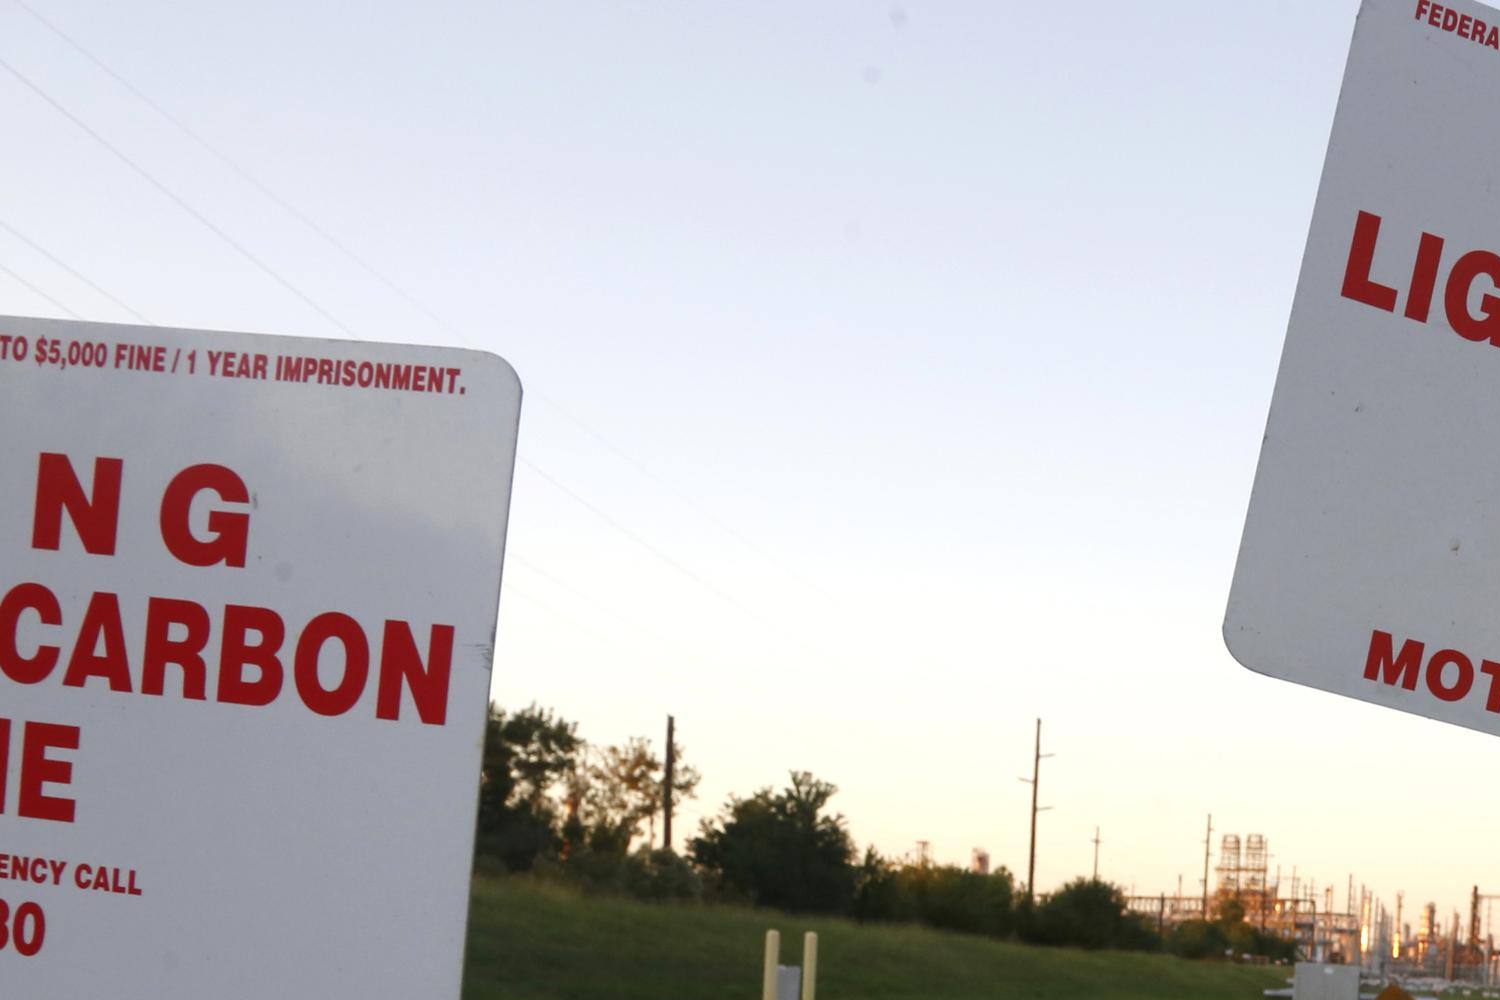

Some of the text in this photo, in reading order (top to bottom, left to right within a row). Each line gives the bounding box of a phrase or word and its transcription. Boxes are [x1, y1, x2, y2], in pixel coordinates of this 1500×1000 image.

[0, 334, 467, 395] TO $5,000 FINE / 1 YEAR IMPRISONMENT.
[0, 581, 456, 727] CARBON
[73, 863, 143, 897] CALL
